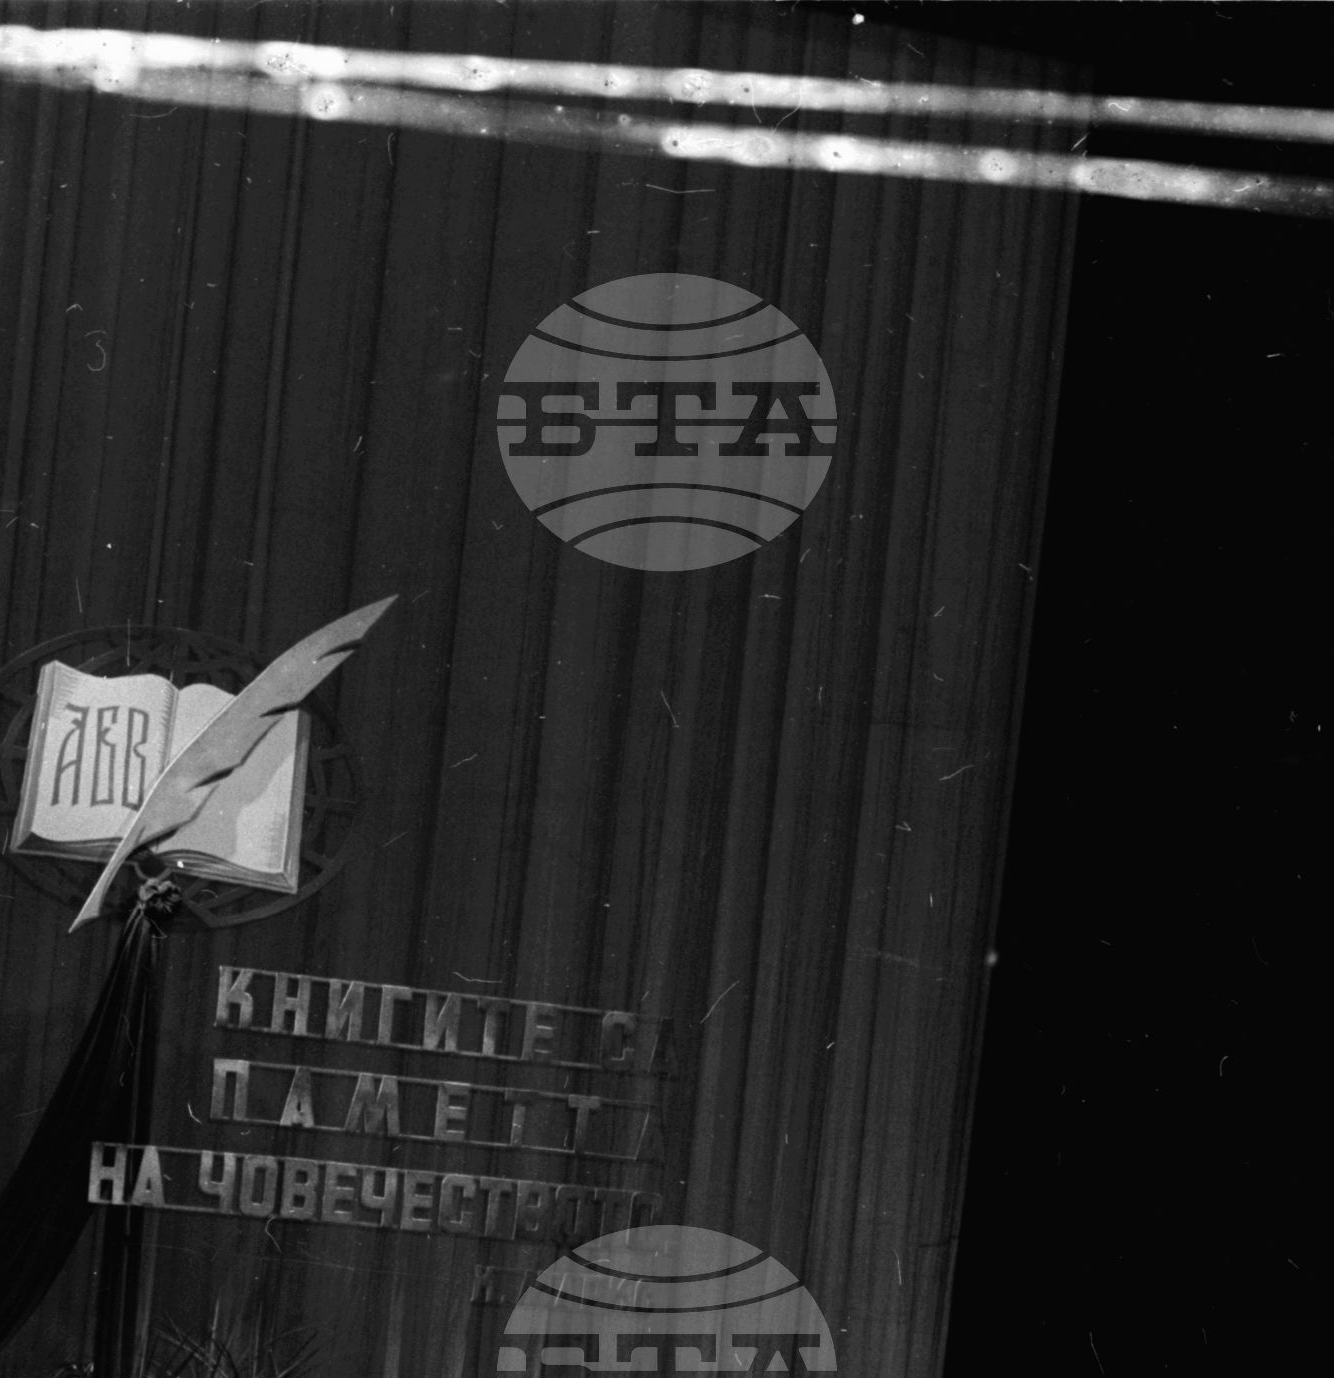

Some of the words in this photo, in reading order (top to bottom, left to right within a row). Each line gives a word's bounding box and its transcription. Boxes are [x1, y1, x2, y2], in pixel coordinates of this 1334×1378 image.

[51, 703, 149, 811] АБВ
[214, 965, 557, 1062] КНИГИТЕ
[87, 1141, 165, 1206] НА
